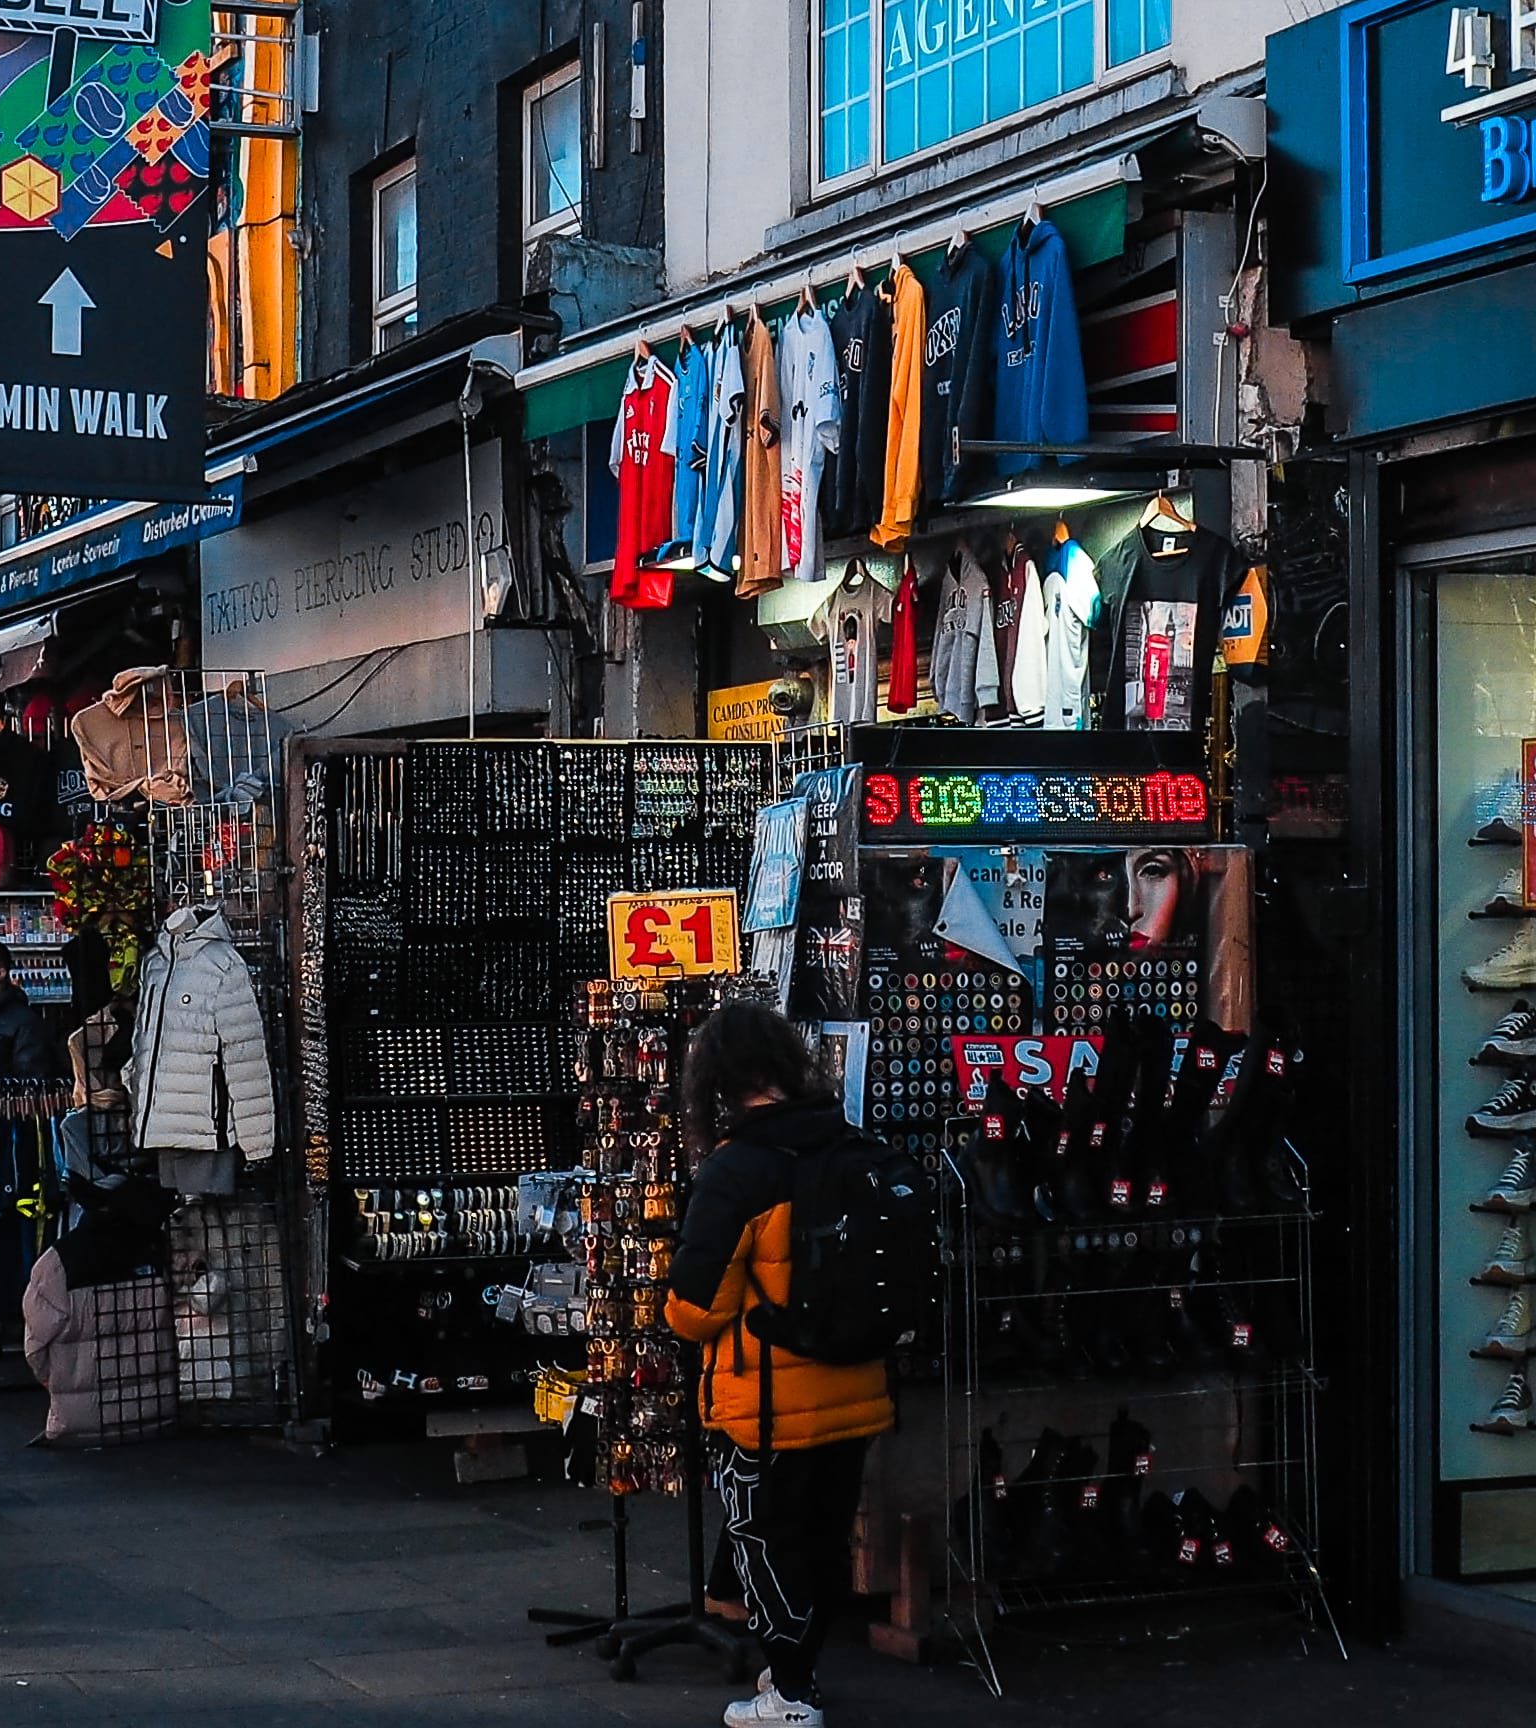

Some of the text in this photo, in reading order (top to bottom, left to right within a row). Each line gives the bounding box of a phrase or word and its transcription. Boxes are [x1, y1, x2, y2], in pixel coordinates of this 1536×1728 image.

[69, 390, 168, 441] WALK
[8, 564, 40, 592] Piercing
[51, 552, 80, 577] London
[142, 506, 190, 544] Disturbed
[206, 511, 495, 636] TATTOO PIERCING STUDIO
[1223, 607, 1252, 631] ADT
[713, 699, 755, 724] CAMDEN
[811, 802, 836, 818] KEEP
[809, 821, 838, 837] CALM
[1003, 891, 1014, 909] &
[623, 904, 715, 969] £1
